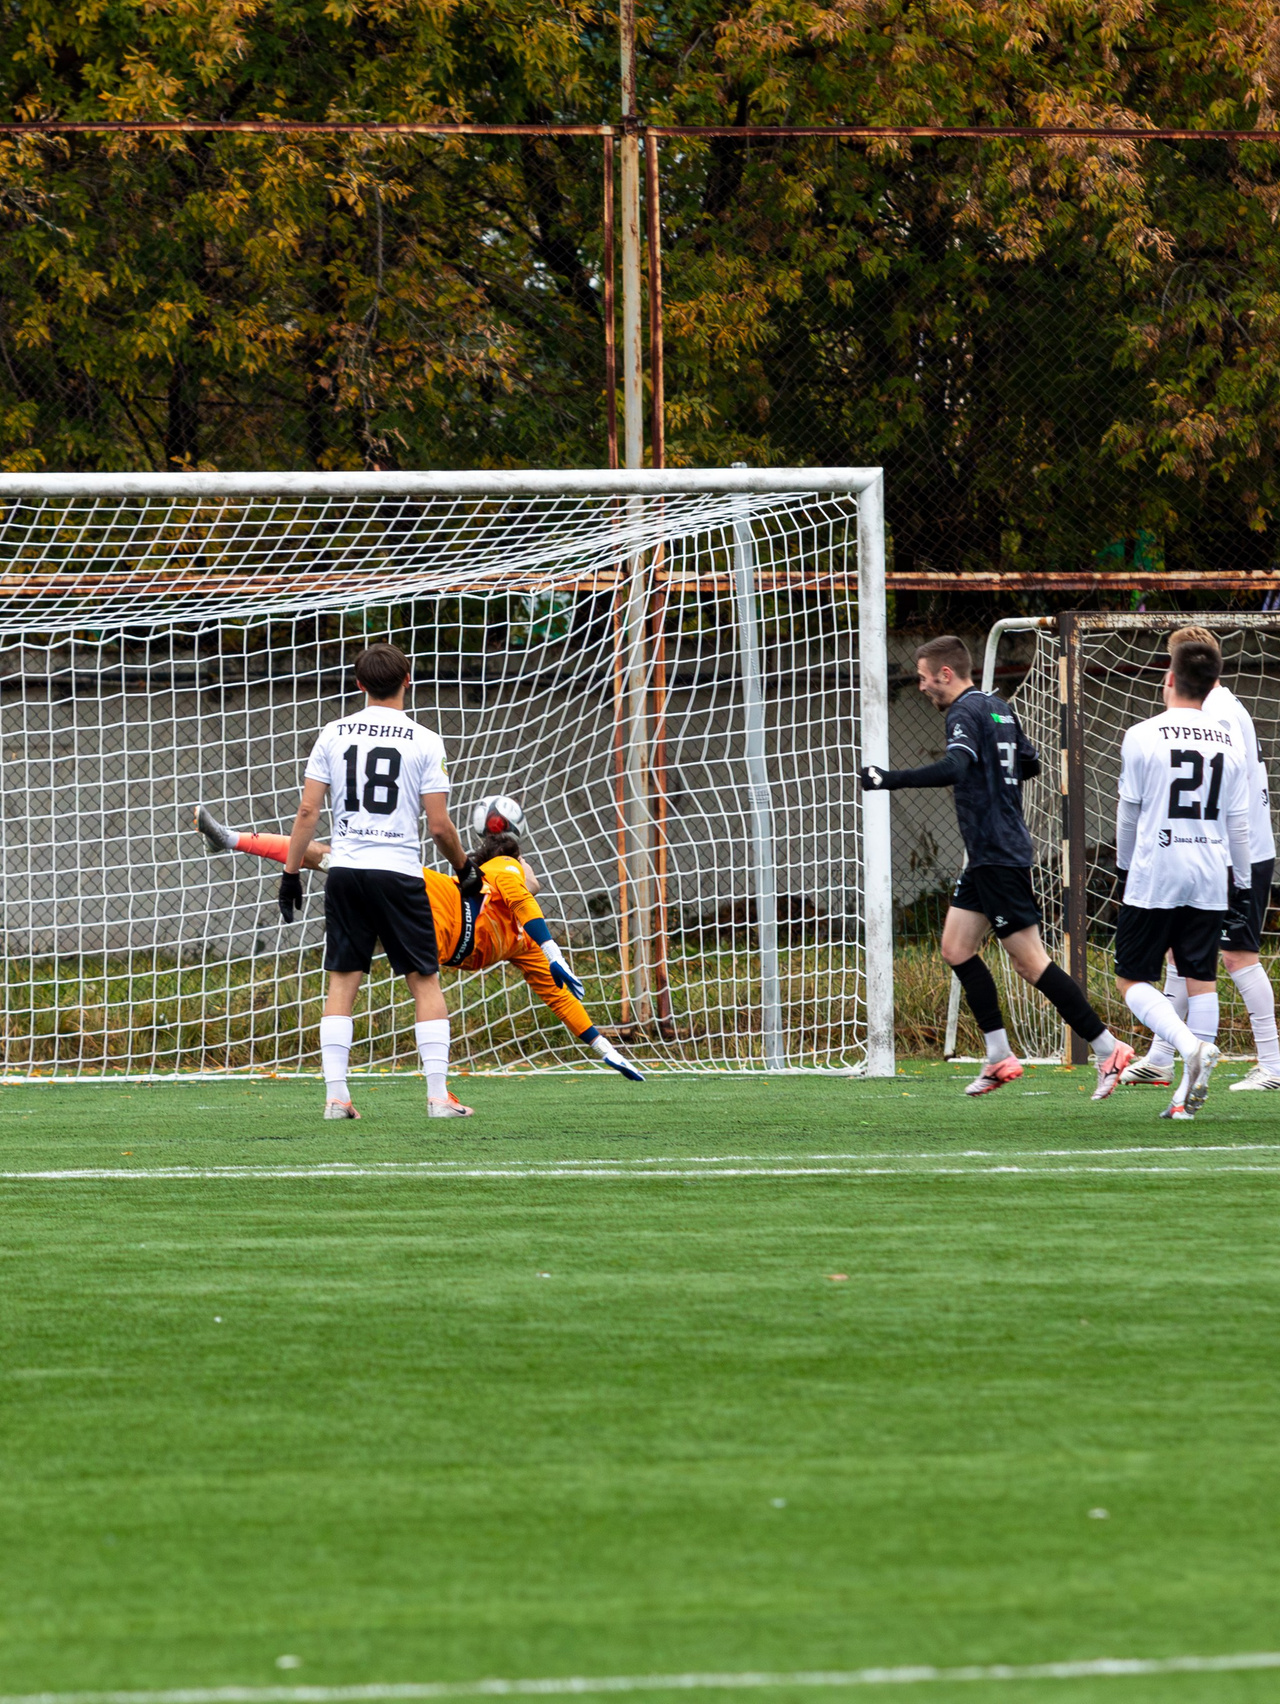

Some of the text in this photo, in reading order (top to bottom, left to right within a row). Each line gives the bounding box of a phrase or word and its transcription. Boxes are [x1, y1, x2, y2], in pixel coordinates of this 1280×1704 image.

[337, 723, 414, 740] ТУРБИНА
[1159, 726, 1233, 747] ТУРБИНА
[343, 744, 402, 815] 18
[1168, 749, 1224, 820] 21
[463, 901, 473, 923] PRO
